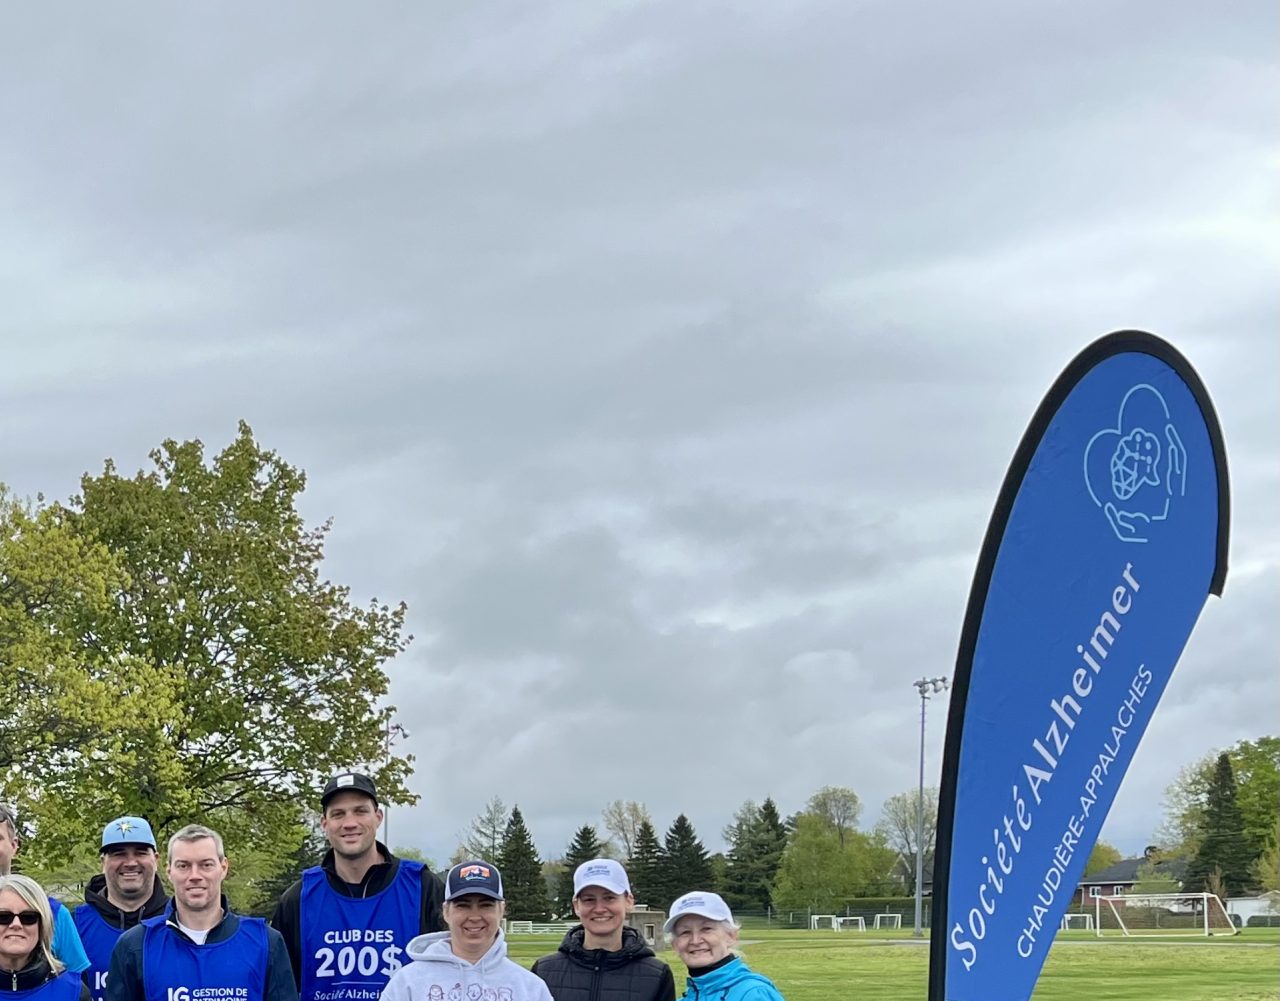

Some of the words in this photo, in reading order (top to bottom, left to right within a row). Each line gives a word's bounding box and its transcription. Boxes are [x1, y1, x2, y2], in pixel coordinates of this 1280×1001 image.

[951, 785, 1033, 971] Société
[1023, 562, 1141, 805] Alzheimer
[1017, 664, 1153, 960] CHAUDIÈRE-APPALACHES
[324, 929, 361, 944] CLUB
[364, 929, 394, 943] DES
[314, 944, 403, 979] 200$
[192, 988, 234, 998] GESTION
[235, 988, 248, 997] DE
[345, 989, 380, 999] Alzhei
